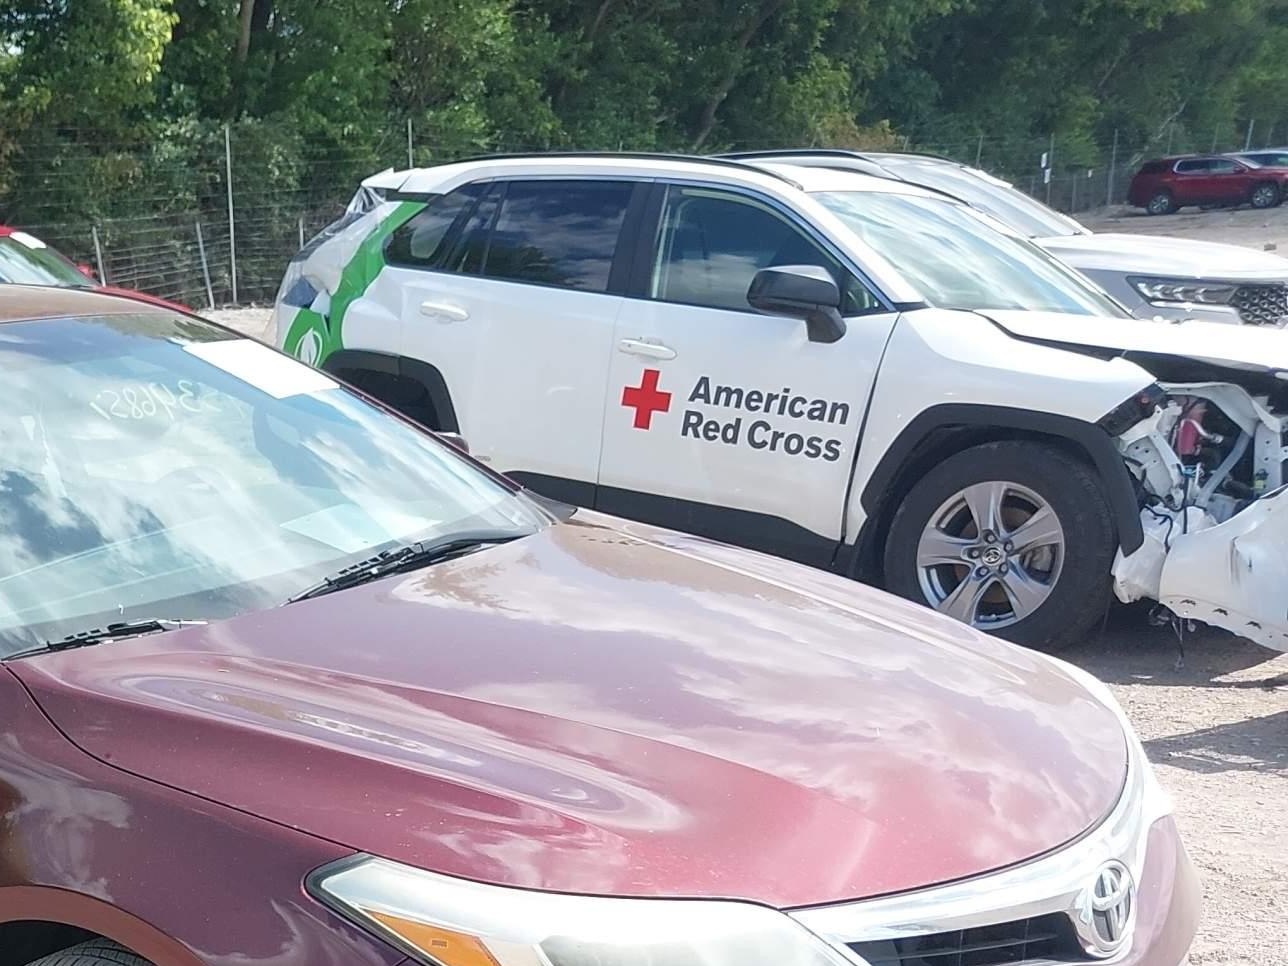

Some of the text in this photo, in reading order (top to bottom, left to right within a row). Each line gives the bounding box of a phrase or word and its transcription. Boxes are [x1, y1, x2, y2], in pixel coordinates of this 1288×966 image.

[688, 376, 850, 425] American
[681, 410, 842, 462] Red Cross
